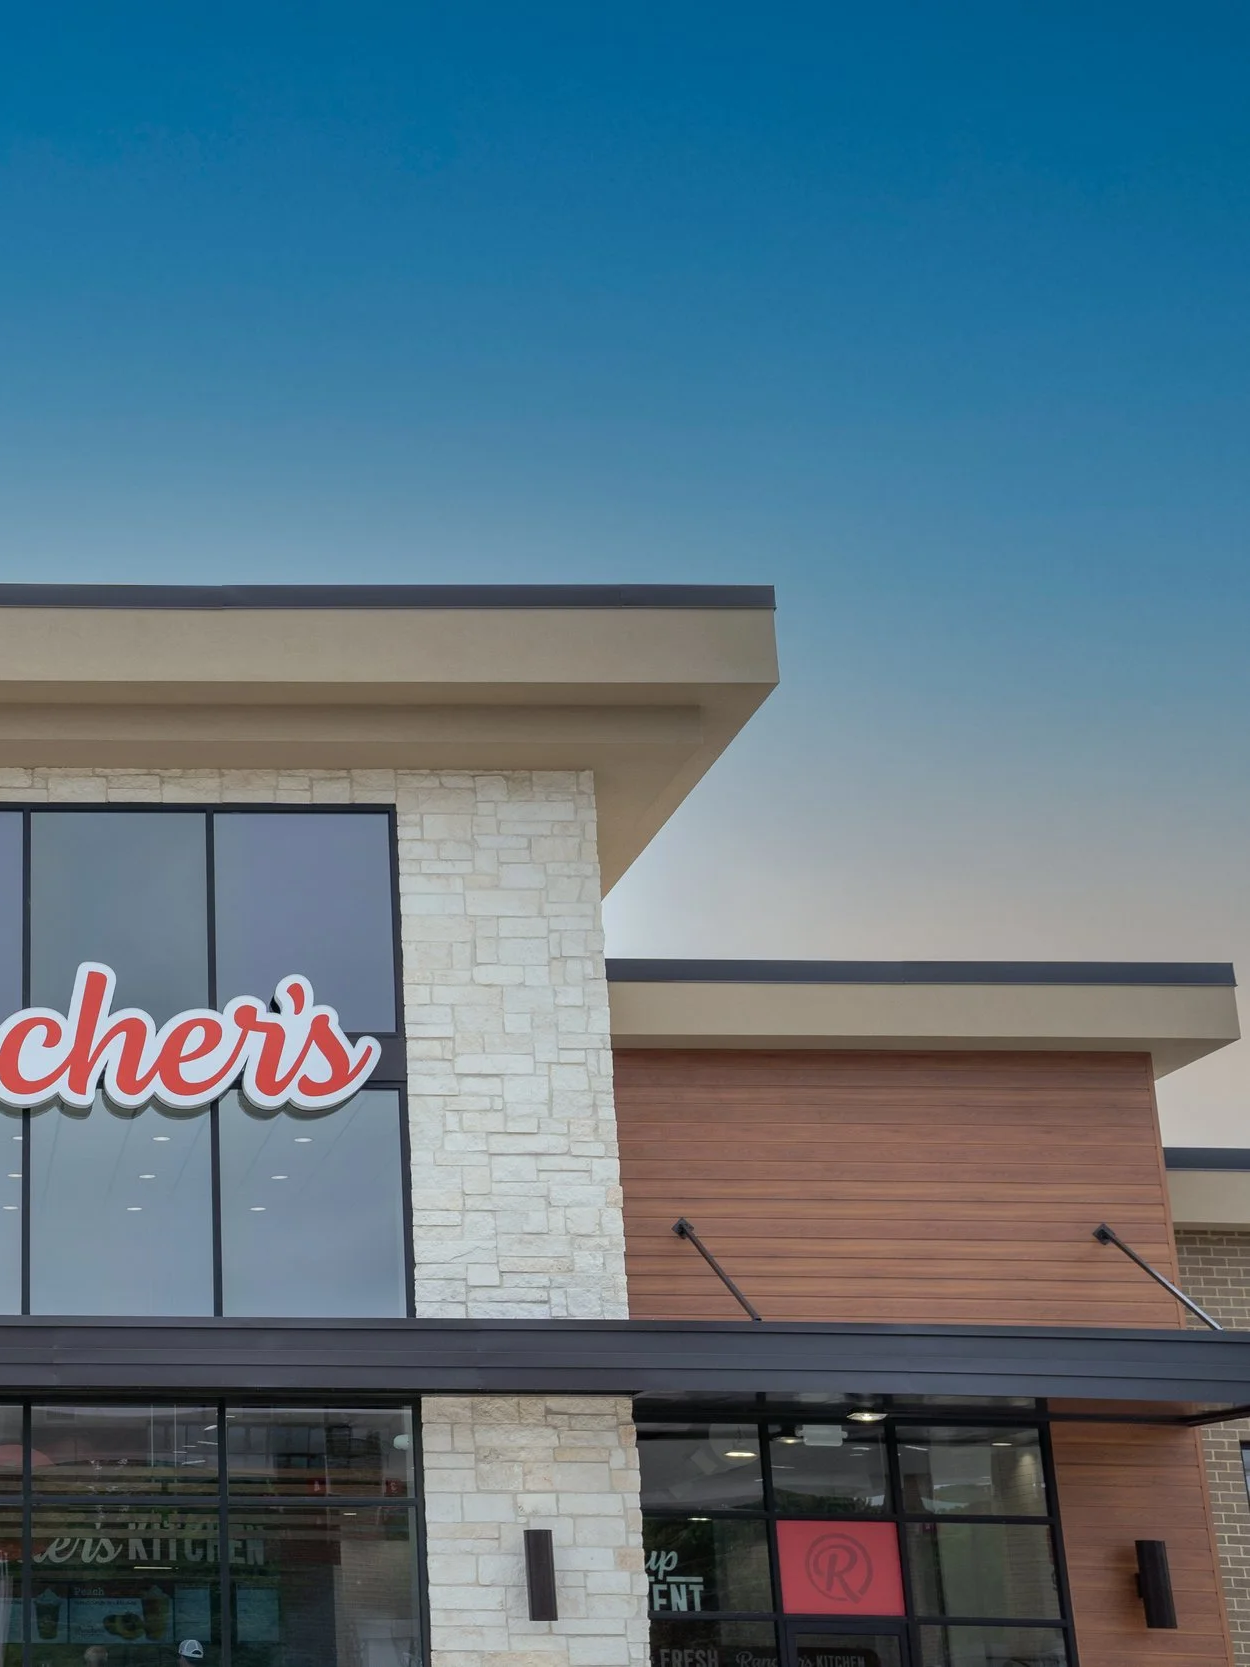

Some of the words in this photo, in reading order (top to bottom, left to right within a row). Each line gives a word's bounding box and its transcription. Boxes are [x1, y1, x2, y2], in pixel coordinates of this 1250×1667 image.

[128, 1521, 265, 1566] KITCHEN
[813, 1543, 861, 1604] R
[659, 1647, 720, 1667] FRESH
